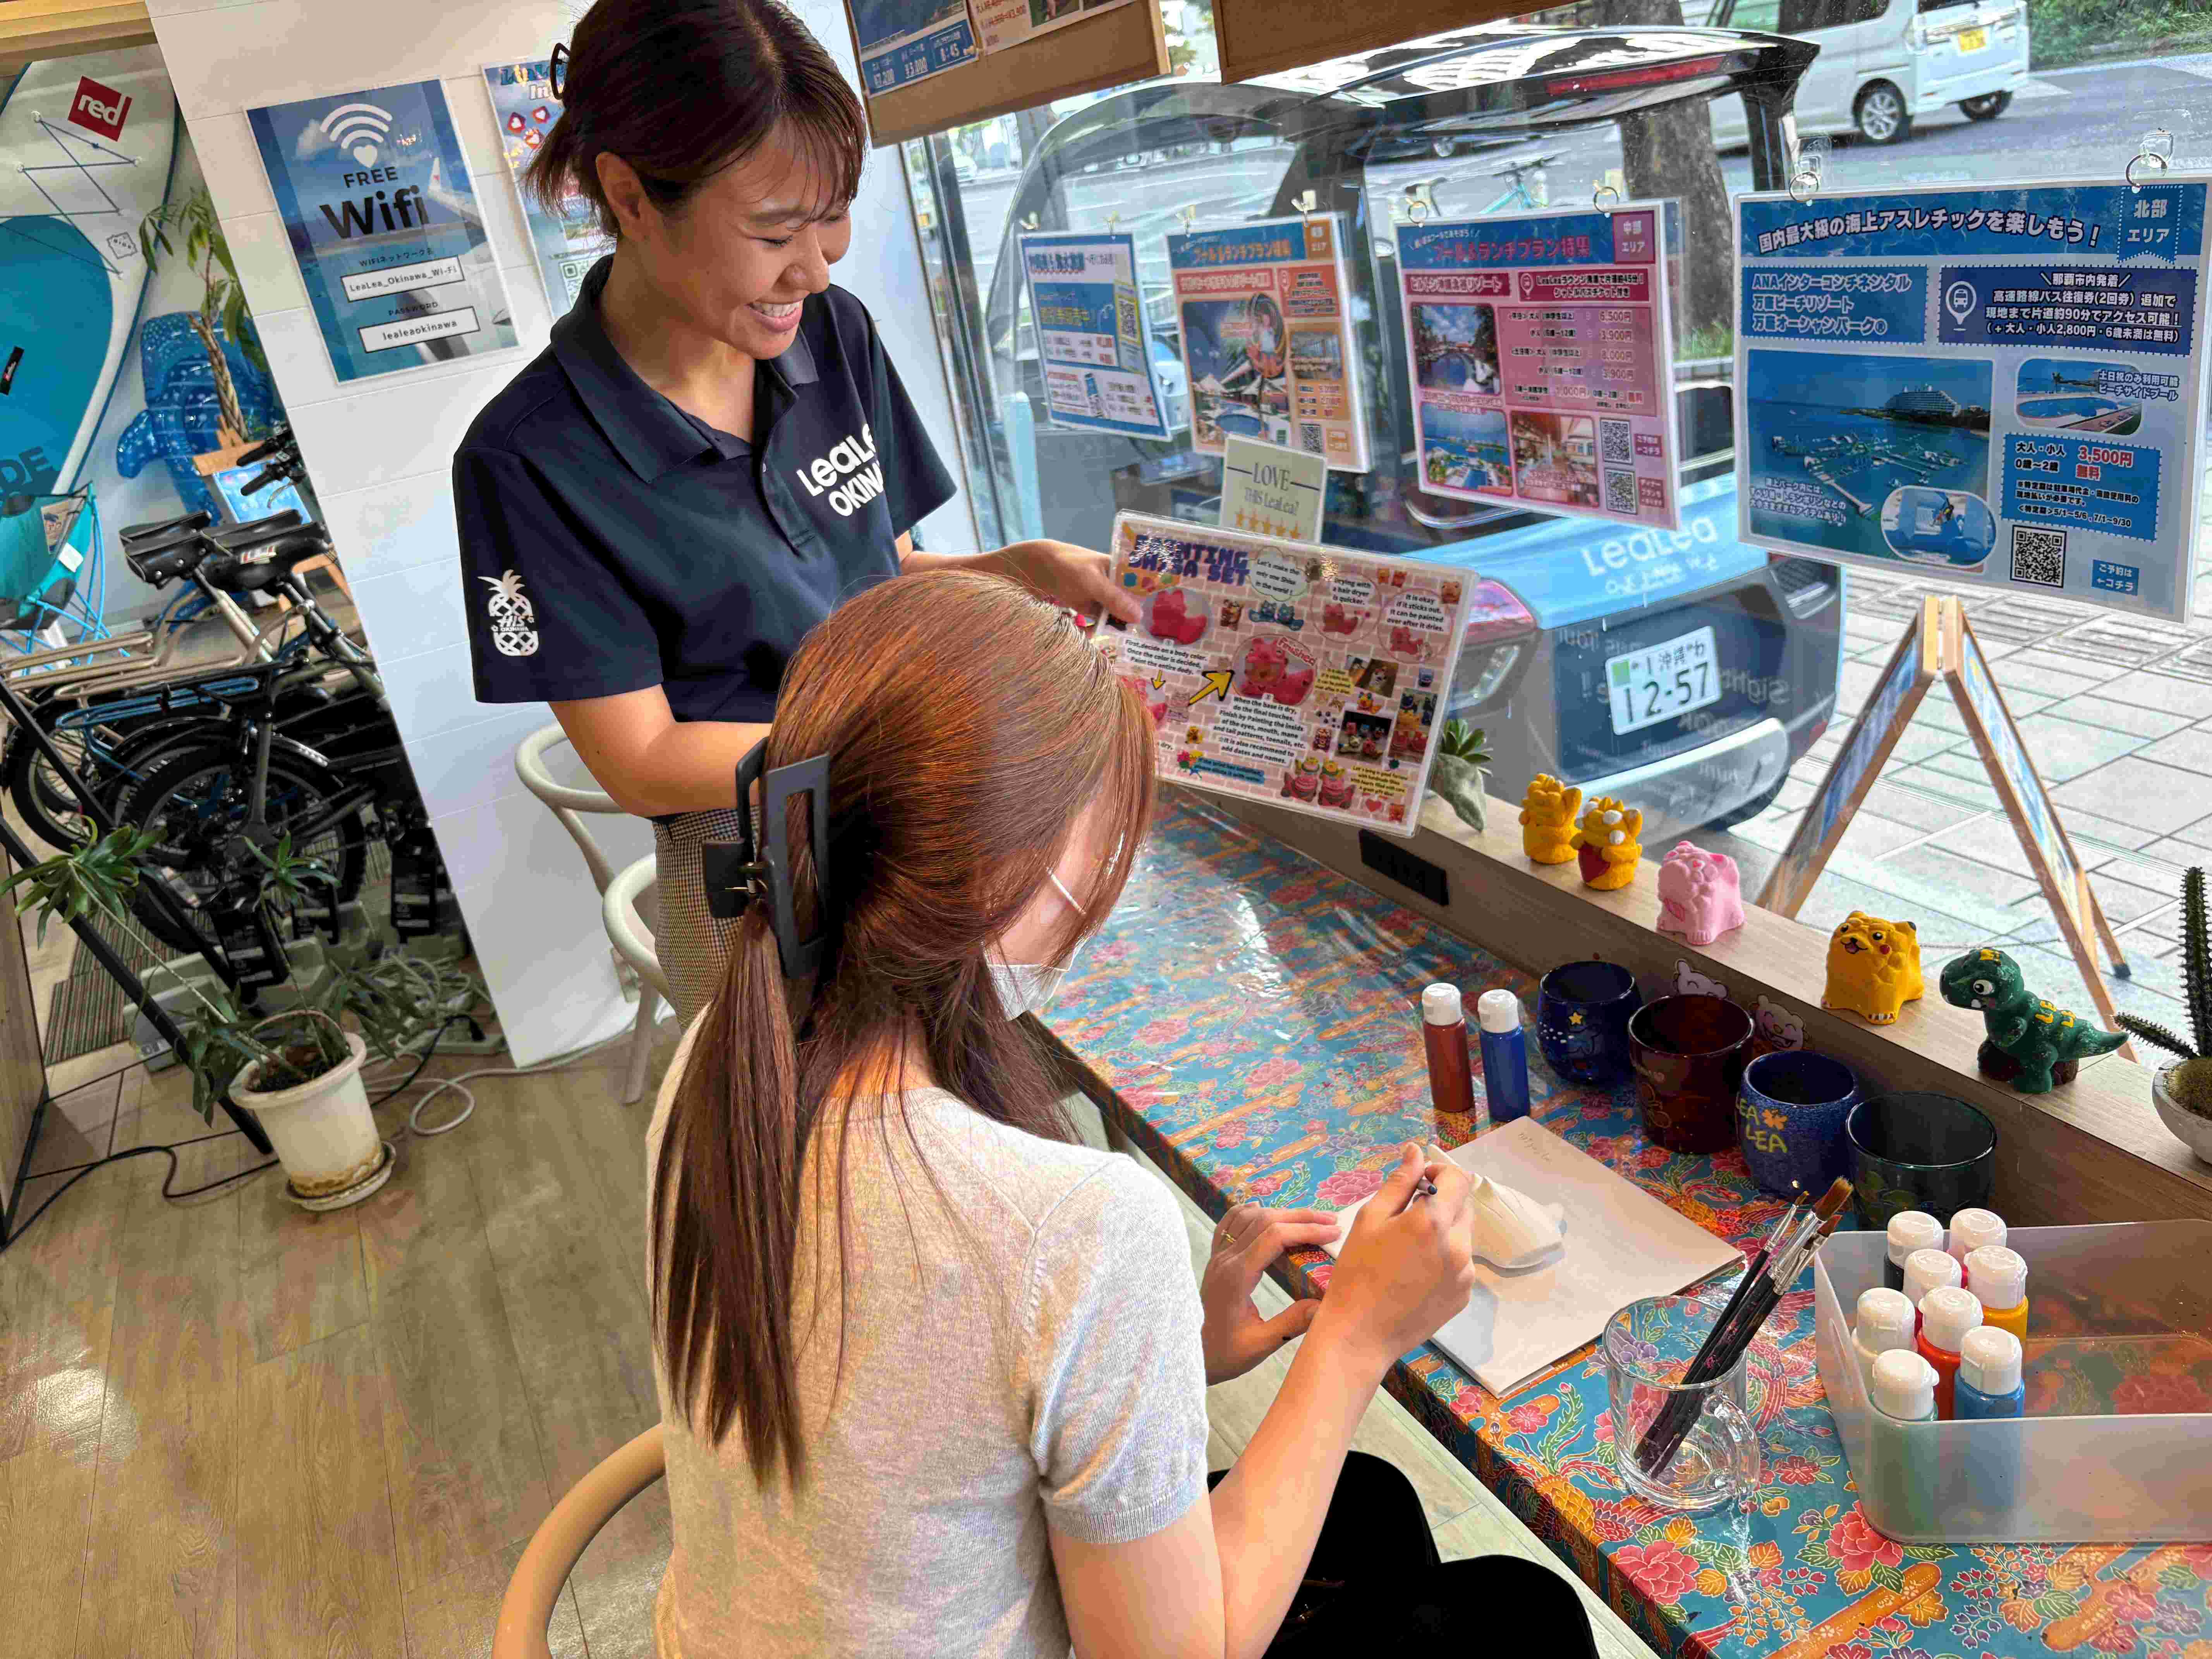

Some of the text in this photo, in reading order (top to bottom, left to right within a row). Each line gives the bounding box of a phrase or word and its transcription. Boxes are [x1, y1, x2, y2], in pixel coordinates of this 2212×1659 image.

[77, 94, 120, 126] red
[343, 167, 398, 188] FREE
[319, 185, 429, 239] Wifi
[2134, 199, 2168, 219] 北部
[2127, 228, 2169, 243] エリア
[1621, 241, 1646, 253] エリア
[1752, 273, 1912, 292] ANAインターコンチネンタル
[388, 301, 438, 316] PASSWORD
[382, 321, 458, 340] lealeaokinawa
[2099, 369, 2180, 388] 土日祝のみ利用可能
[2099, 385, 2179, 402] ビーチサイドプール
[796, 423, 876, 497] LeaLe
[2078, 446, 2133, 467] 3,500円
[1253, 462, 1291, 492] LOVE
[2075, 464, 2100, 481] 無料
[1580, 516, 1718, 576] LeaLea
[1207, 563, 1250, 586] SET
[1272, 564, 1288, 573] make
[2098, 564, 2133, 578] ご予約は
[1273, 585, 1288, 594] world
[1338, 586, 1350, 594] hair
[1351, 589, 1370, 598] dryer
[1339, 596, 1365, 606] quicker.
[1408, 603, 1427, 611] sticks
[1419, 597, 1435, 605] okay
[1418, 613, 1444, 623] painted
[1426, 623, 1444, 632] dries.
[1127, 647, 1142, 656] Once
[1154, 654, 1169, 663] color
[1175, 649, 1189, 659] body
[1190, 653, 1207, 661] color.
[1278, 637, 1317, 666] Finished
[1130, 656, 1146, 665] Paint
[1158, 662, 1175, 670] entire
[1623, 661, 1709, 725] 12-57
[1268, 713, 1295, 722] touches.
[1284, 706, 1297, 715] dry,
[1247, 716, 1273, 726] Painting
[1240, 723, 1256, 731] eyes,
[1257, 726, 1279, 736] mouth,
[1237, 729, 1265, 742] patterns,
[1266, 736, 1293, 747] toenails,
[1233, 747, 1251, 757] dates
[1264, 755, 1286, 763] names.
[1236, 740, 1249, 748] also
[1249, 743, 1287, 756] recommend
[1745, 1124, 1788, 1154] LEA
